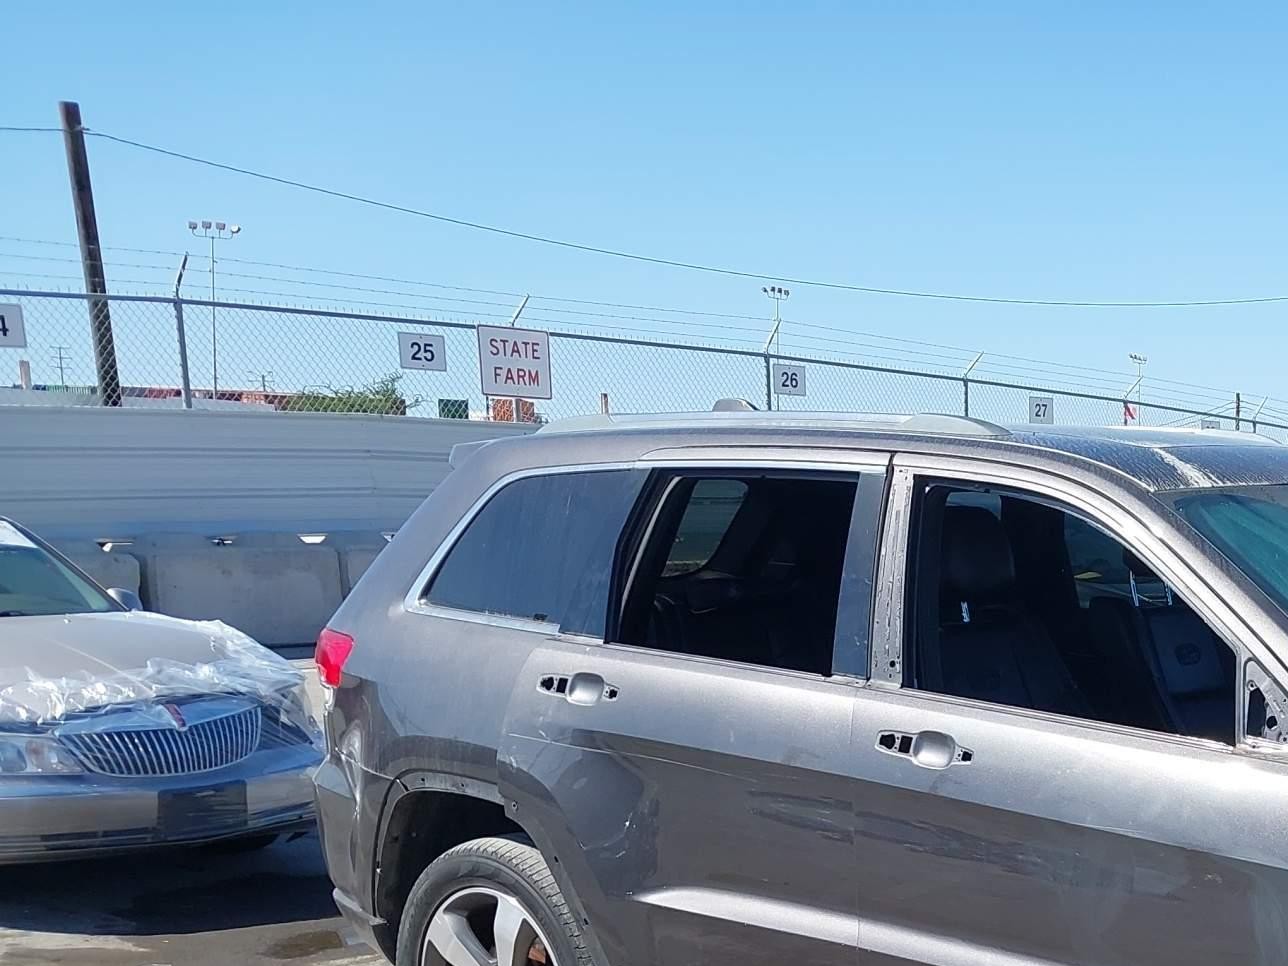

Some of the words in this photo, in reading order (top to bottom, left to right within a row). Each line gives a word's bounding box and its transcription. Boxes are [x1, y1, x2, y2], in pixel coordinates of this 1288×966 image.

[410, 341, 435, 362] 25
[489, 338, 541, 360] STATE
[494, 366, 540, 387] FARM
[781, 371, 799, 389] 26
[1035, 403, 1048, 418] 27
